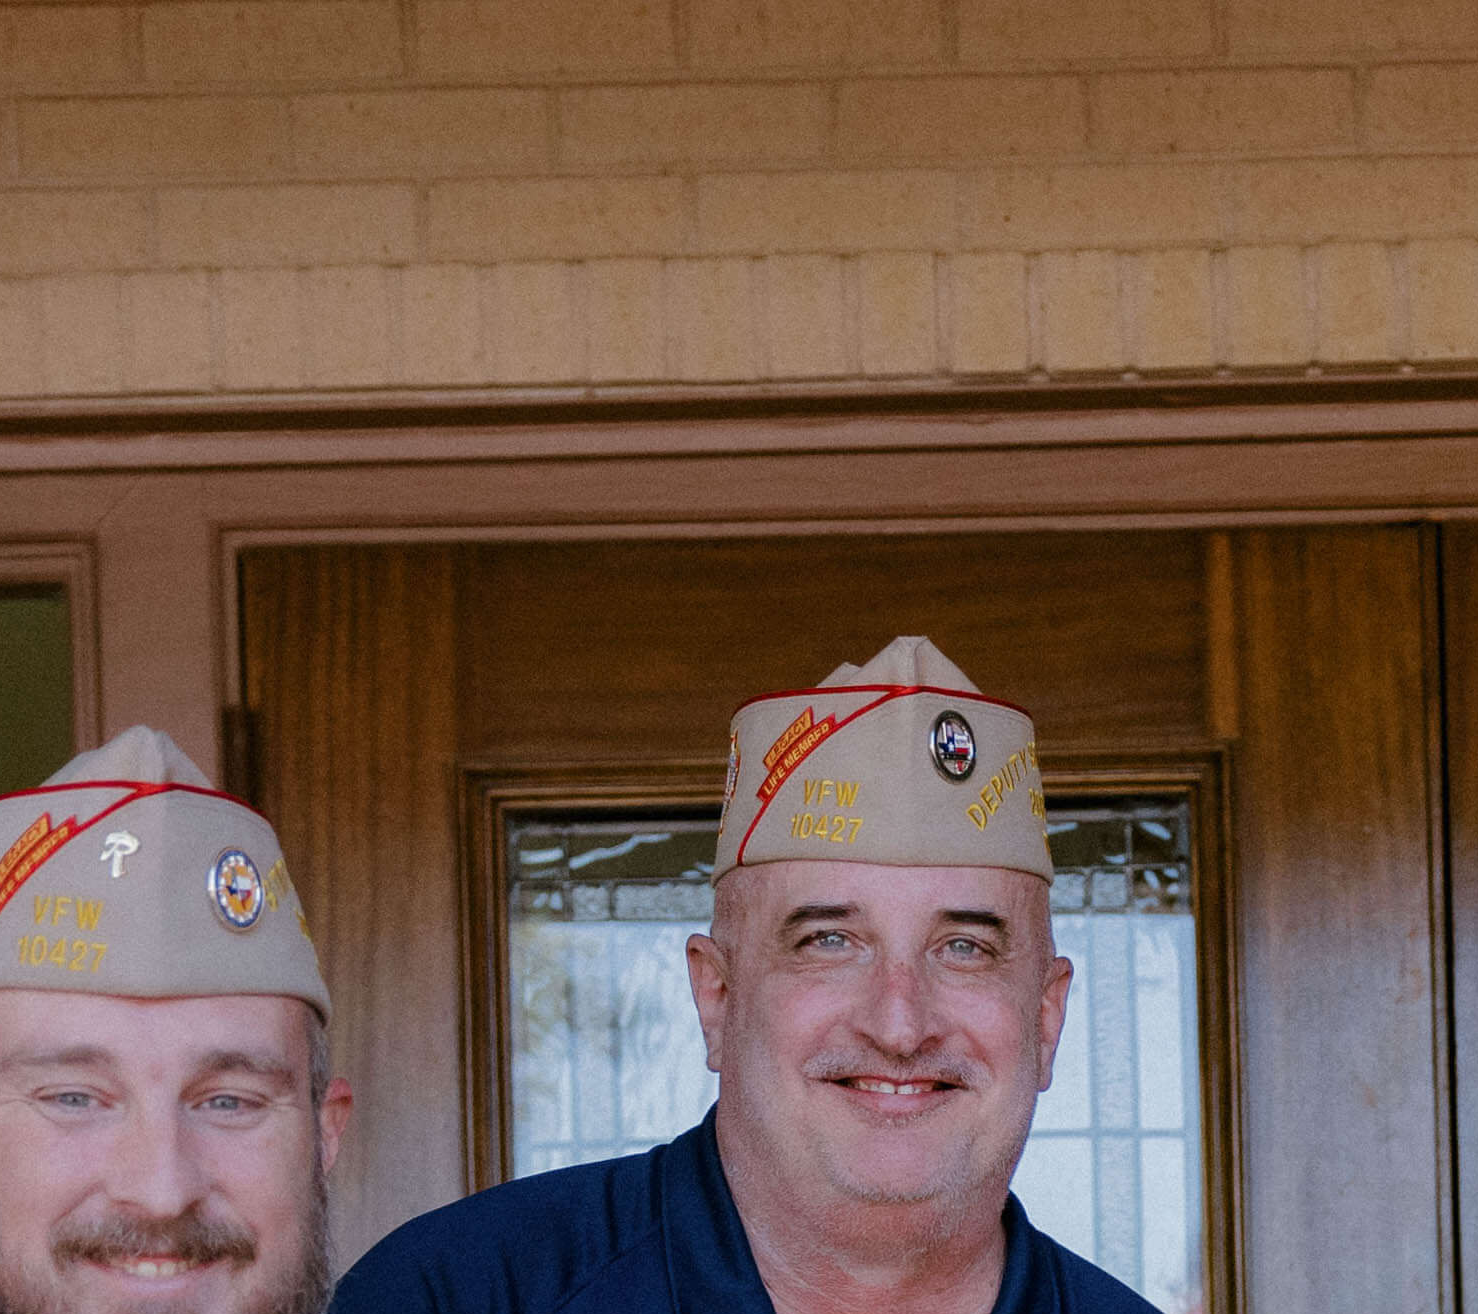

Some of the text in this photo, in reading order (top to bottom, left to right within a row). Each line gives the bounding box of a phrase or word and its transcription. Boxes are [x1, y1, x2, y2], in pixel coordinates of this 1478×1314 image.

[803, 778, 861, 808] VFW
[967, 748, 1027, 831] DEPUTY
[790, 813, 864, 843] 10427
[33, 895, 103, 931] VFW
[17, 934, 108, 973] 10427
